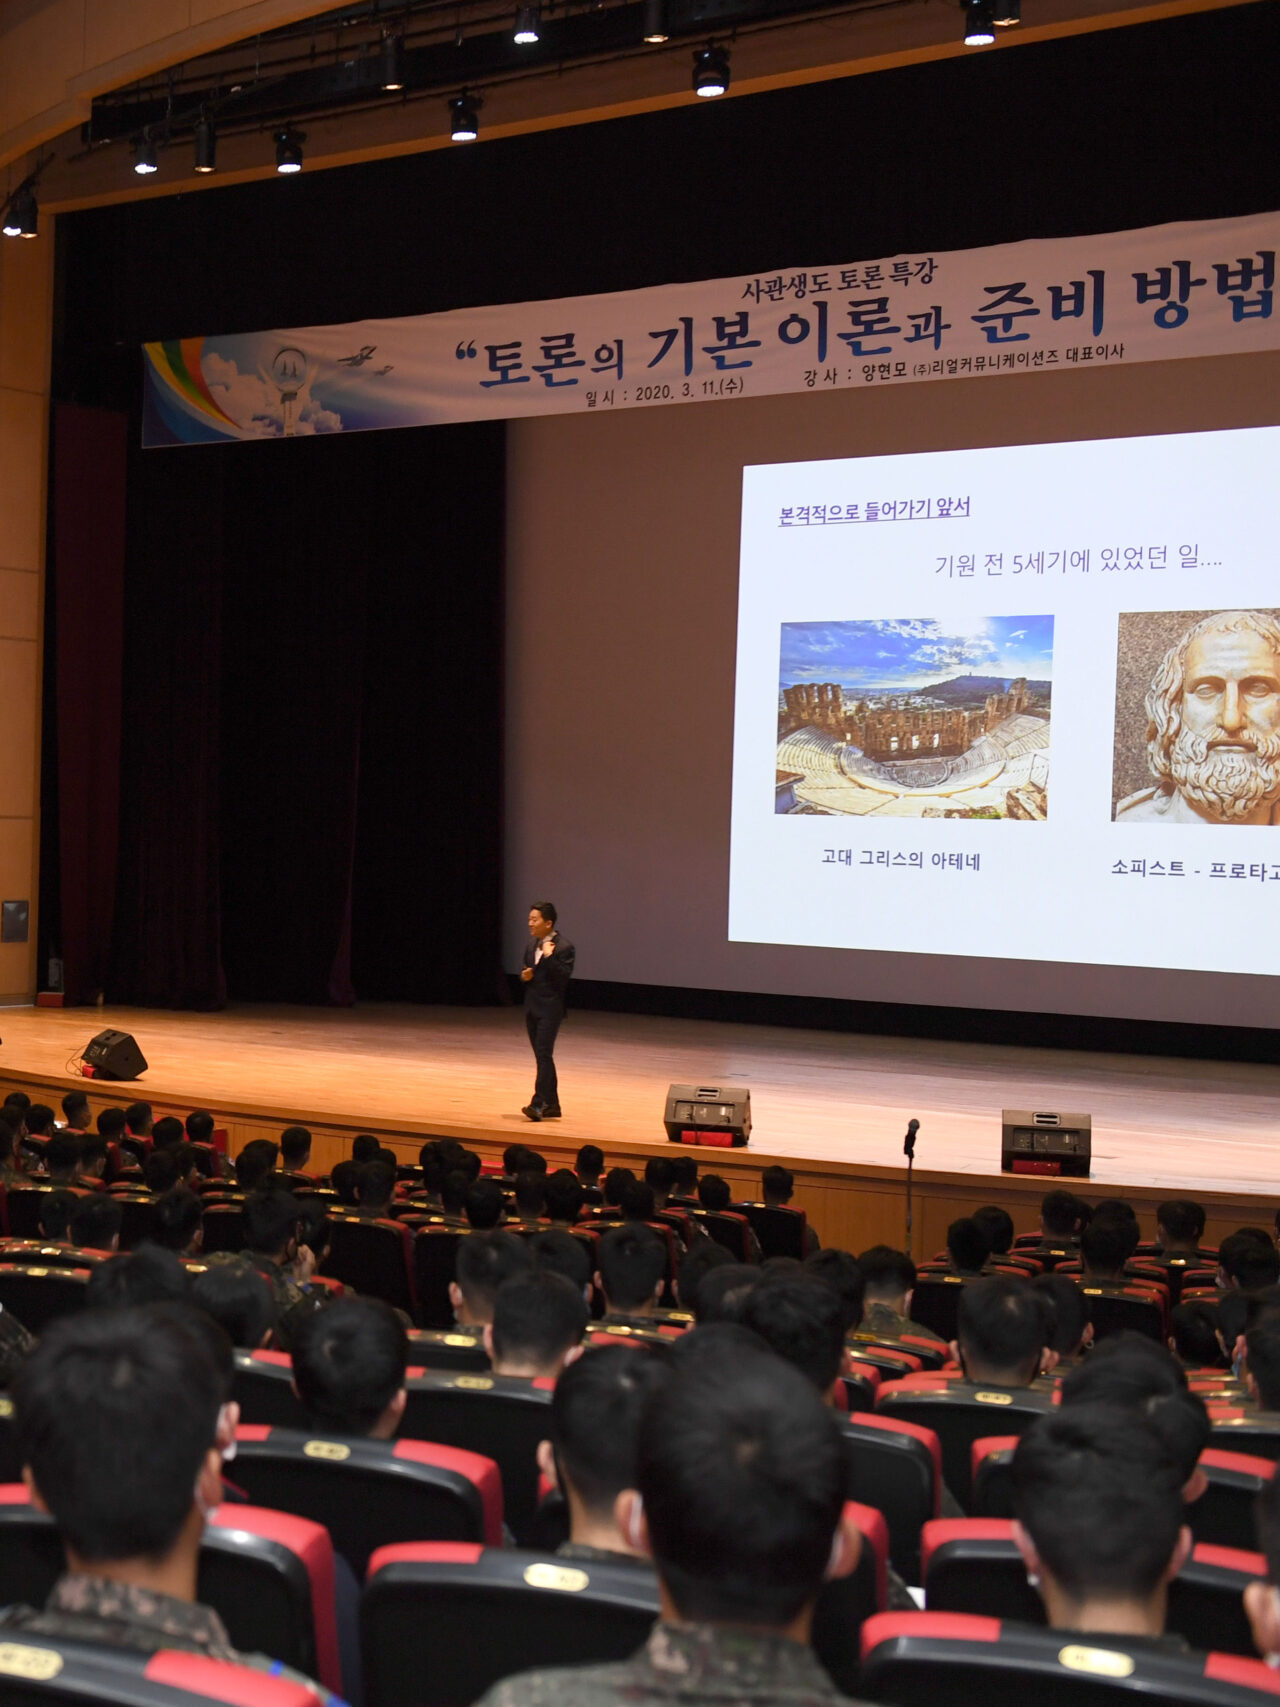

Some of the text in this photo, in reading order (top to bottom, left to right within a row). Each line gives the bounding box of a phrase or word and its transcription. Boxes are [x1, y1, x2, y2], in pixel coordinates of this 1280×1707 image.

[741, 258, 938, 304] 사관생도 토론 특강
[647, 311, 762, 377] 기본
[778, 297, 952, 363] 이론과
[970, 269, 1106, 344] 준비
[1131, 250, 1276, 330] 방법
[862, 361, 908, 383] 양현모
[1066, 343, 1125, 363] 대표이사
[636, 384, 674, 401] 2020.
[682, 382, 694, 398] 3.
[778, 495, 970, 526] 본격적으로 들어가기 앞서
[935, 553, 975, 579] 기원
[983, 552, 1003, 577] 전
[1012, 549, 1090, 575] 5세기에
[1100, 544, 1168, 572] 있었던
[821, 849, 981, 871] 고대 그리스의 아테네
[1111, 858, 1186, 878] 소피스트
